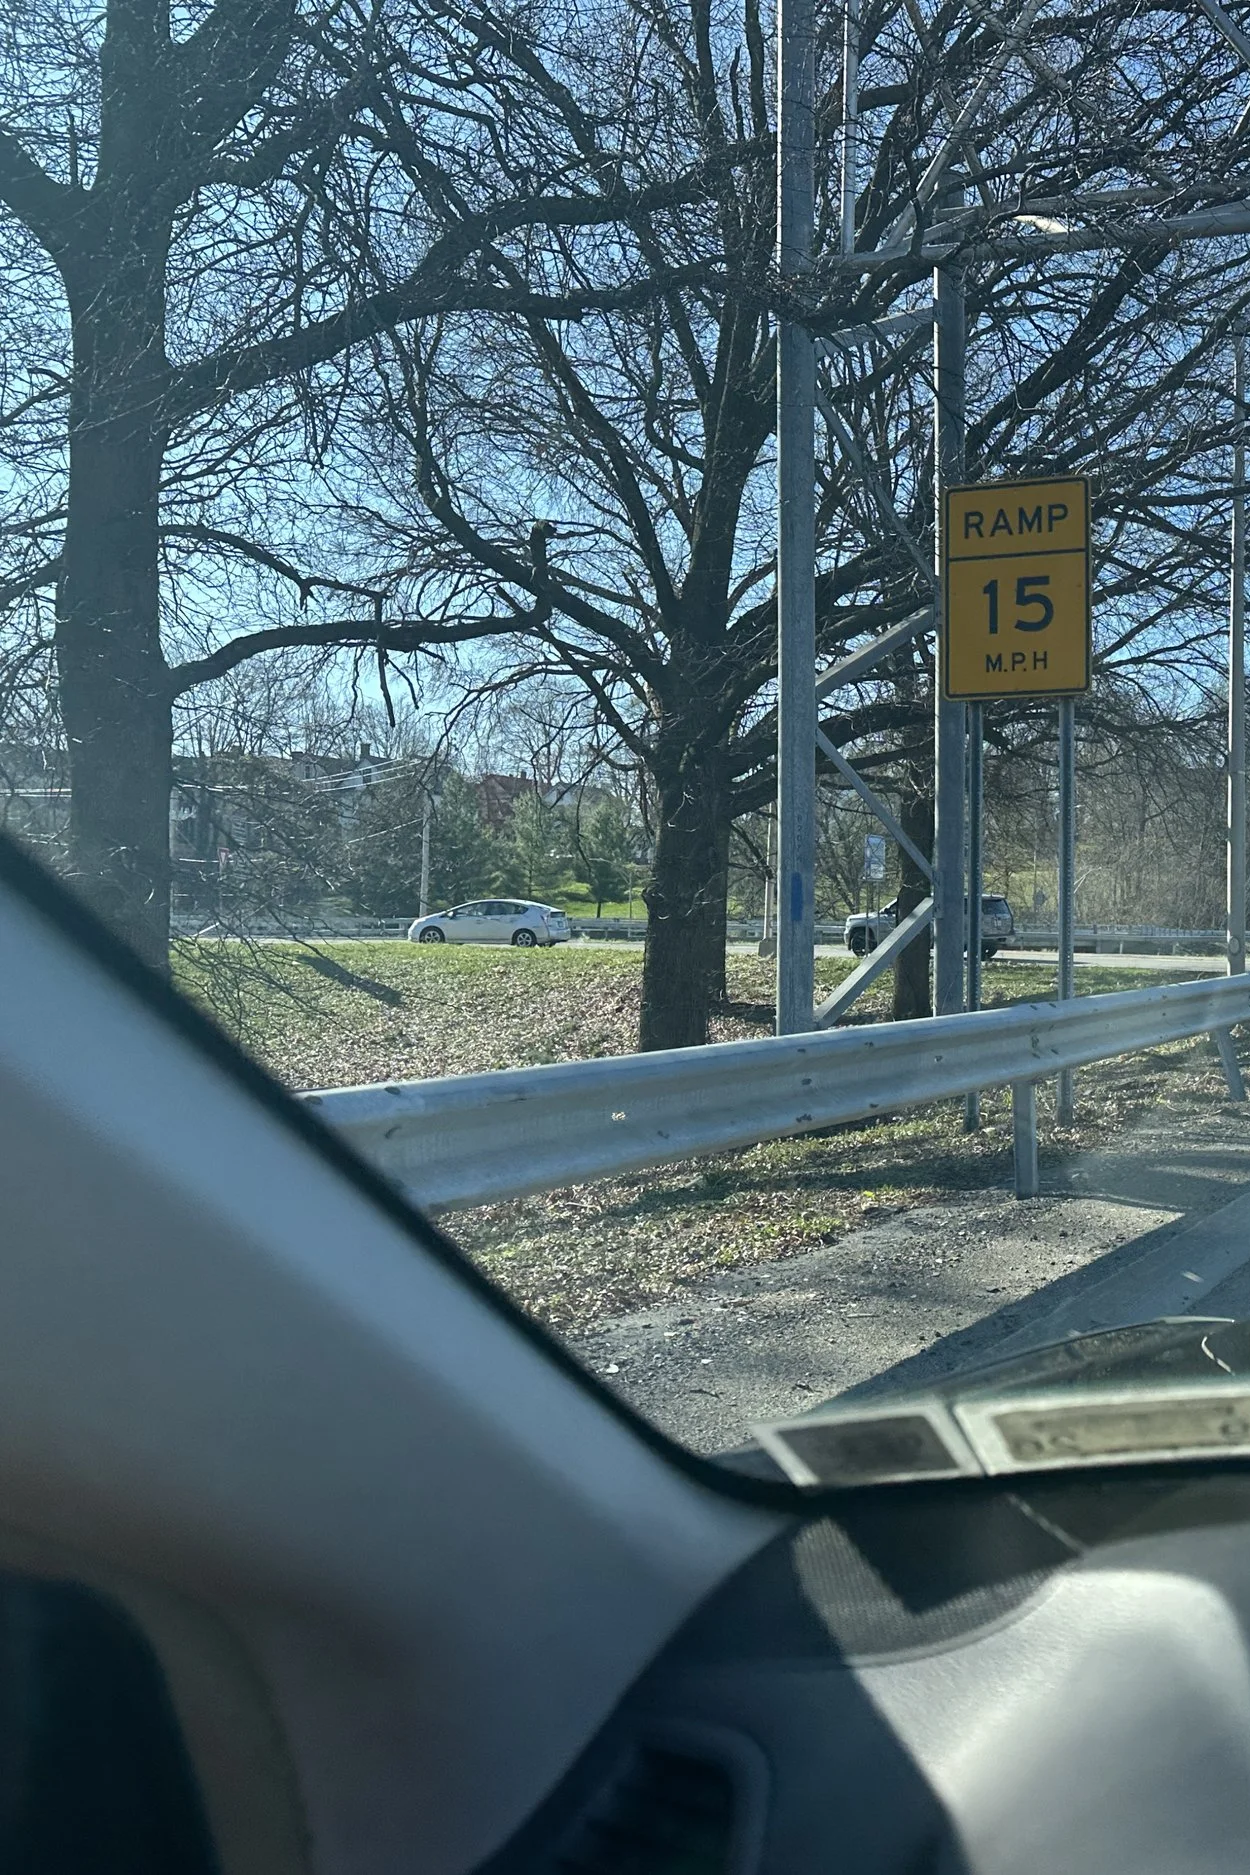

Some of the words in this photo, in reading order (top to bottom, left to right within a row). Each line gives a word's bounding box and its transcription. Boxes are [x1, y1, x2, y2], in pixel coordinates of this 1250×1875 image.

[964, 503, 1069, 539] RAMP
[983, 575, 1055, 635] 15
[985, 651, 1048, 673] M.P.H
